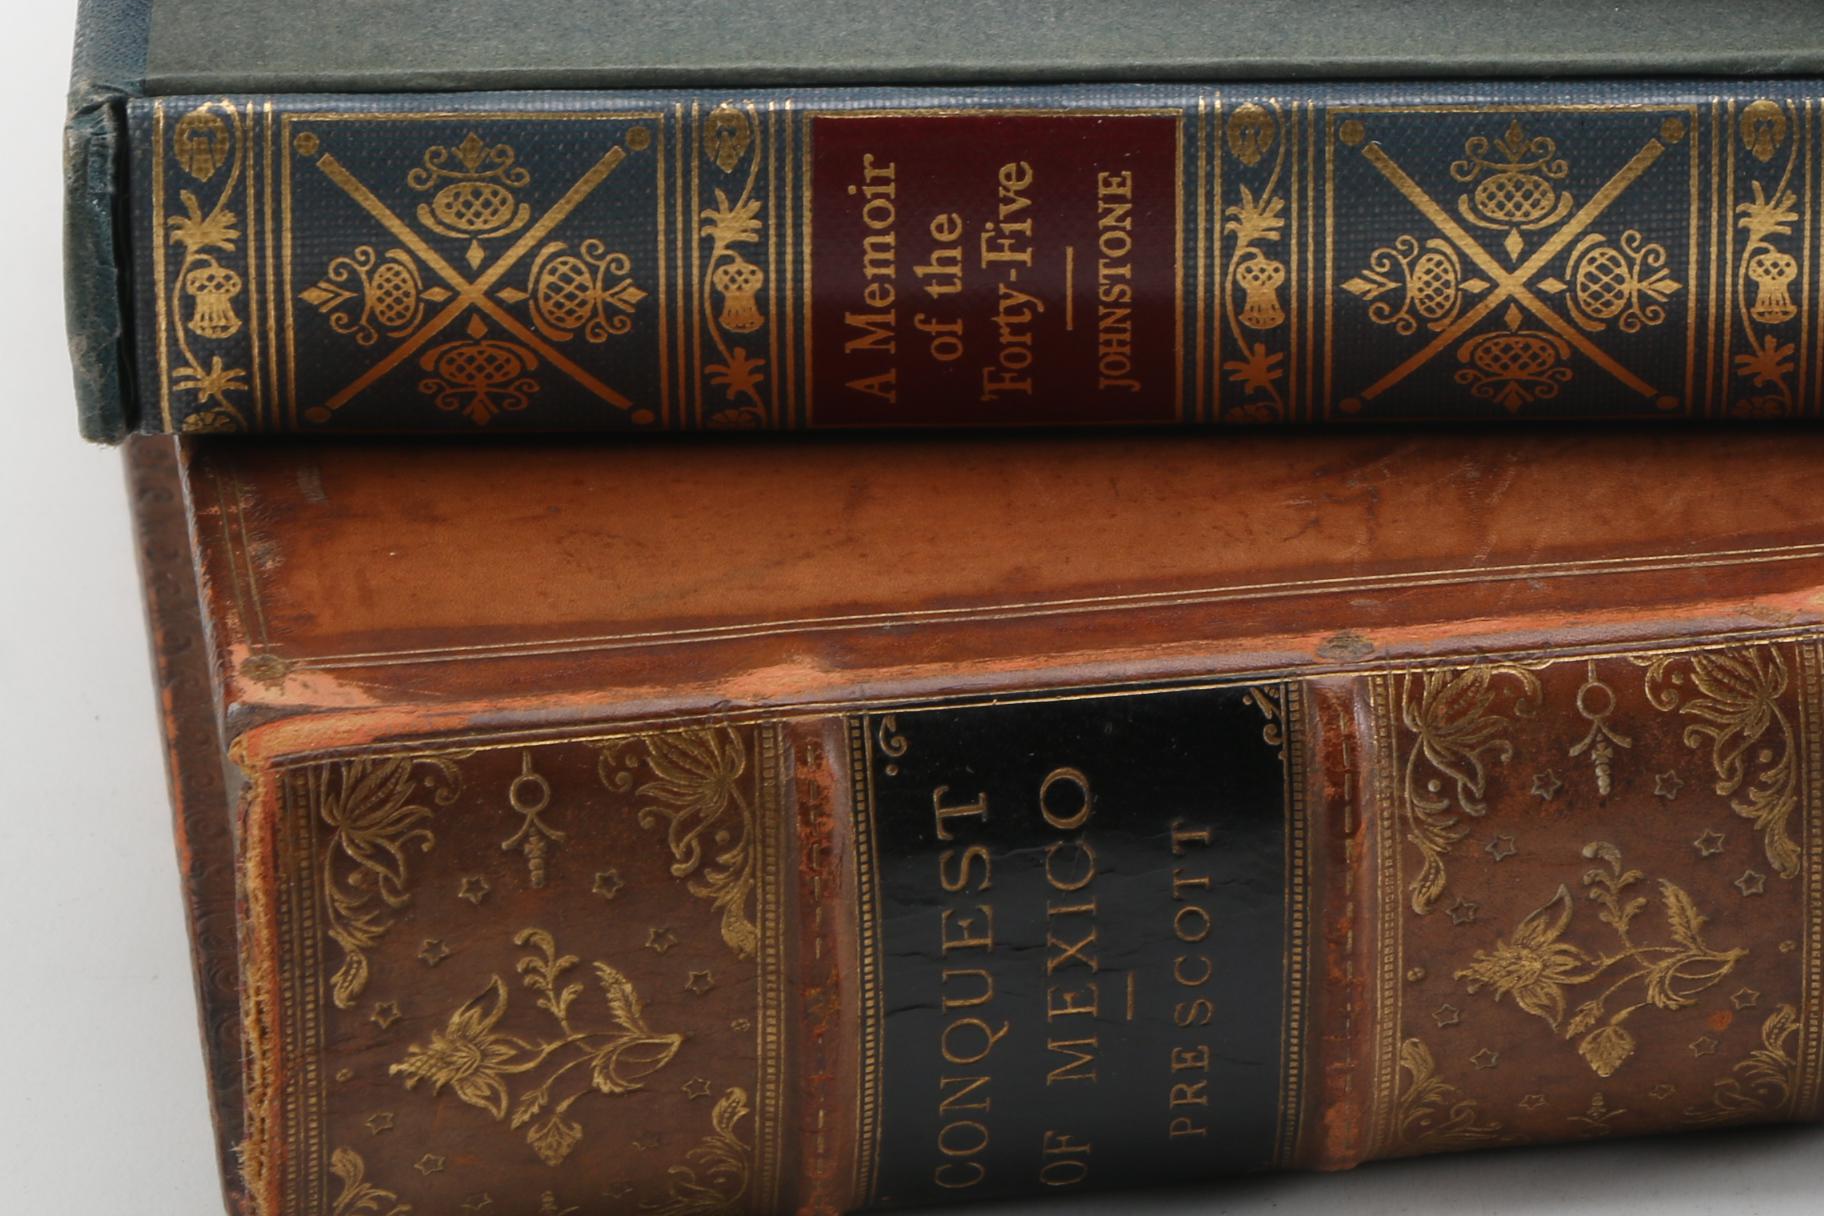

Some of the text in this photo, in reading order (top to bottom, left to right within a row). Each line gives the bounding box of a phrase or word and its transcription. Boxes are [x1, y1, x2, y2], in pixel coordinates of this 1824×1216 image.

[845, 153, 897, 405] A Memoir
[913, 212, 964, 362] of the
[1097, 170, 1141, 392] JOHNSTONE
[932, 785, 1010, 1189] CONQUEST
[1039, 766, 1098, 1187] OF MEXICO
[1169, 818, 1214, 1140] PRESCOTT
